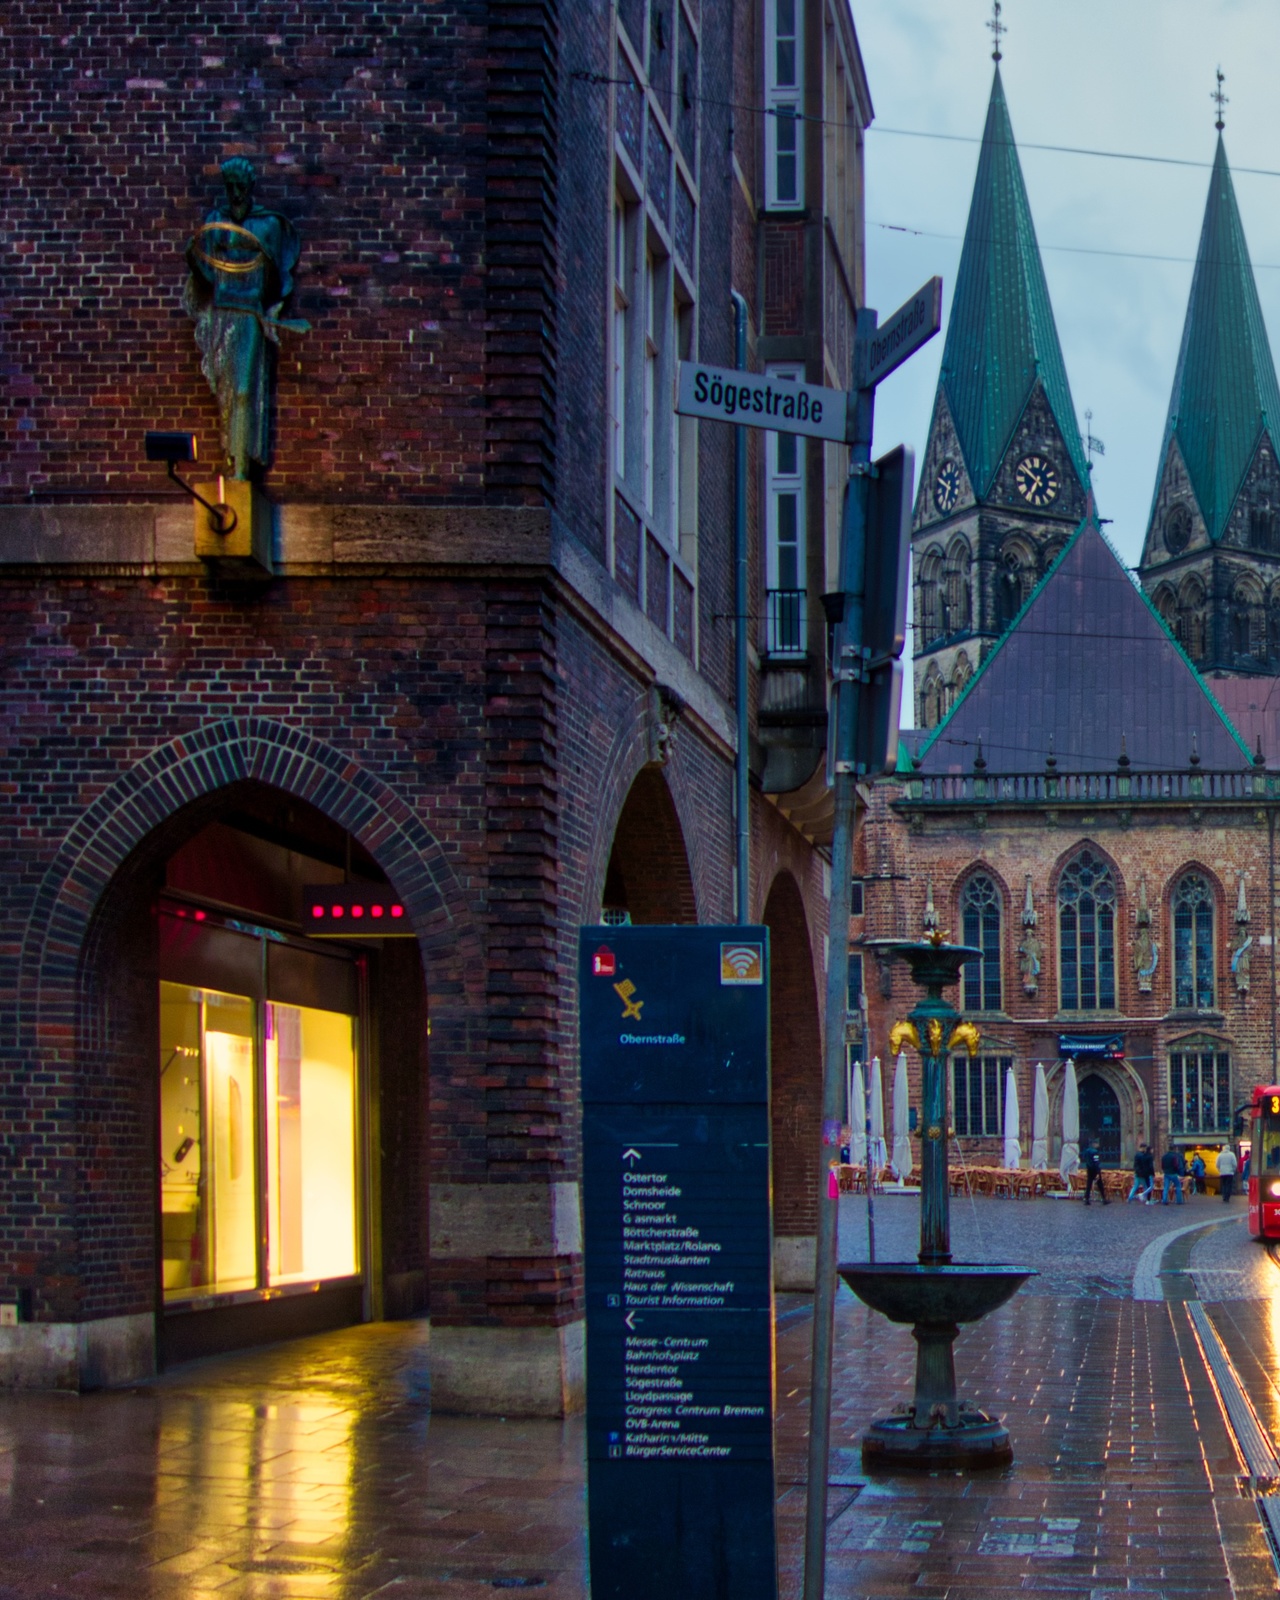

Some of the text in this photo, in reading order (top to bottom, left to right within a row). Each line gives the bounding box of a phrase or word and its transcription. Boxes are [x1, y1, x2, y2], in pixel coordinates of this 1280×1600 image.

[870, 298, 926, 371] Obernstraße
[694, 370, 823, 424] Sögestraße
[619, 1033, 686, 1045] Obernstraße
[1271, 1096, 1280, 1114] 3
[622, 1172, 668, 1184] Ostertor
[622, 1186, 682, 1197] Domsheide
[622, 1199, 667, 1211] Schnoor
[622, 1213, 677, 1224] Gasmarkt
[623, 1226, 699, 1238] Böttcherstraße
[623, 1254, 711, 1266] Stadtmusikanten
[623, 1281, 735, 1293] Haus der Wissenschaft
[625, 1294, 725, 1306] Tourist Information
[625, 1350, 700, 1362] Bahnhofsplatz
[625, 1364, 679, 1375] Herdentor
[625, 1376, 684, 1389] Sögestraße
[625, 1391, 694, 1403] Lloydpassage
[625, 1405, 765, 1417] Congress Centrum Bremen
[625, 1446, 732, 1458] BürgerServiceCenter
